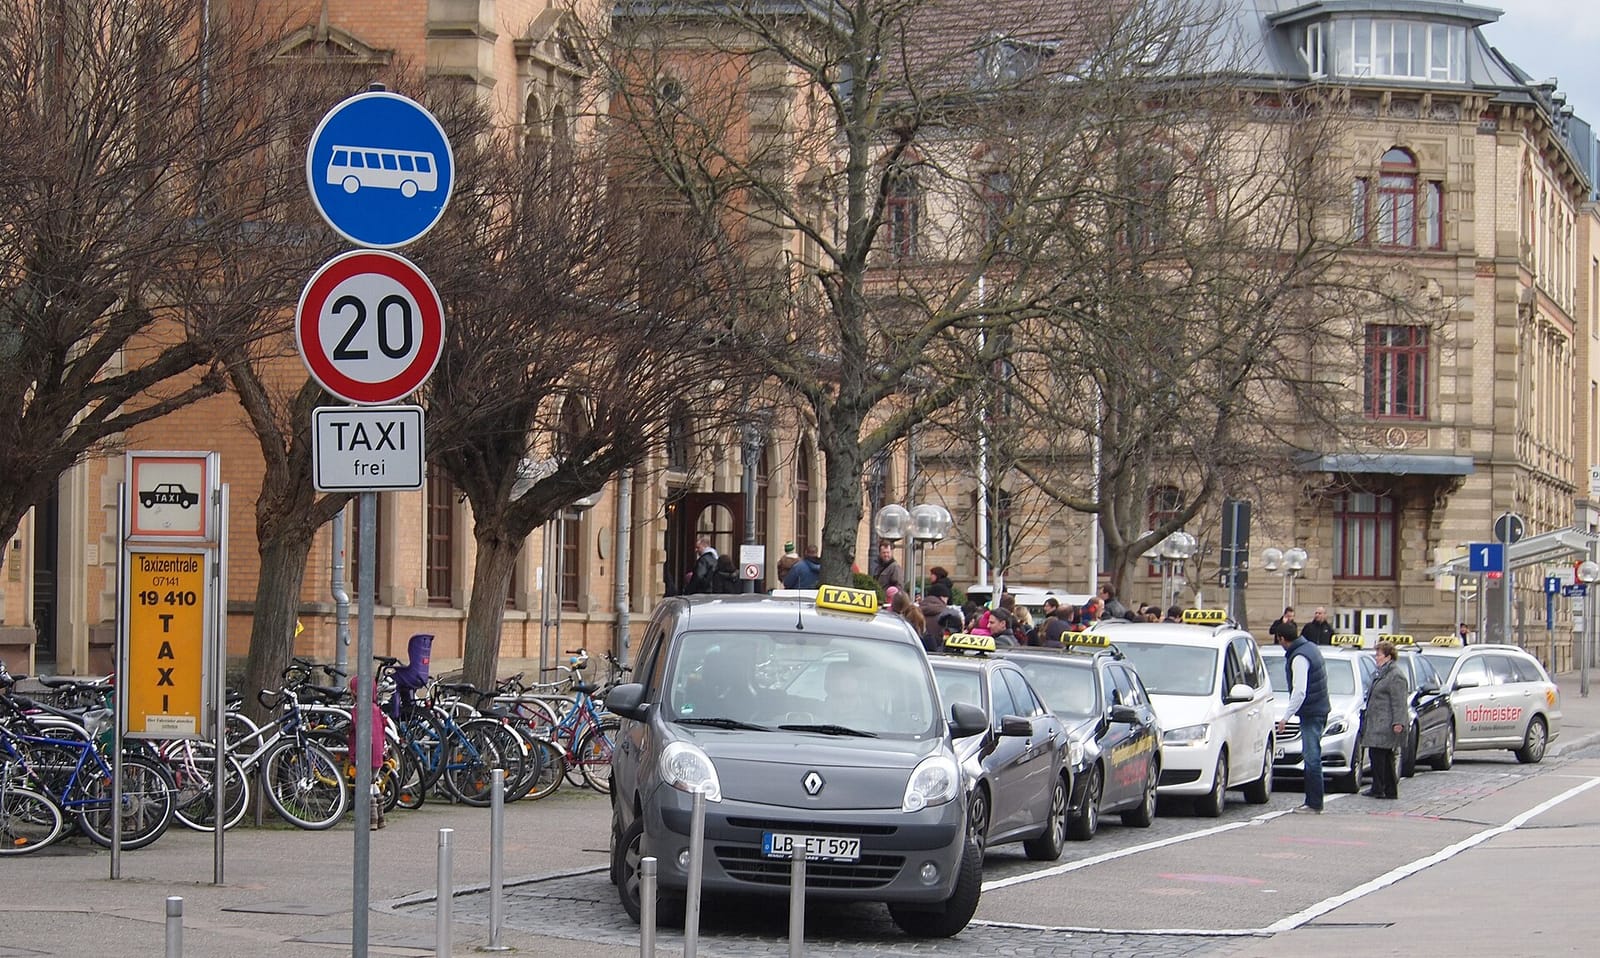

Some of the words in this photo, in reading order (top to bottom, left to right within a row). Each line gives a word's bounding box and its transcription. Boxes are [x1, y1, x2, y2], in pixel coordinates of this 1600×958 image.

[331, 294, 413, 360] 20
[330, 422, 405, 451] TAXI
[354, 459, 386, 476] frei
[155, 493, 179, 502] TAXI
[138, 556, 198, 573] Taxizentrale
[1480, 547, 1489, 568] 1
[152, 577, 179, 586] 07141
[138, 591, 159, 606] 19
[164, 591, 197, 606] 410
[826, 589, 872, 607] TAXI
[953, 634, 988, 647] TAXI
[1067, 633, 1101, 644] TAXI
[1336, 635, 1358, 645] TAXI
[157, 614, 175, 712] TAXI
[1465, 704, 1522, 722] hofmeister
[773, 836, 794, 852] LB
[805, 838, 826, 854] ET
[829, 840, 859, 855] 597
